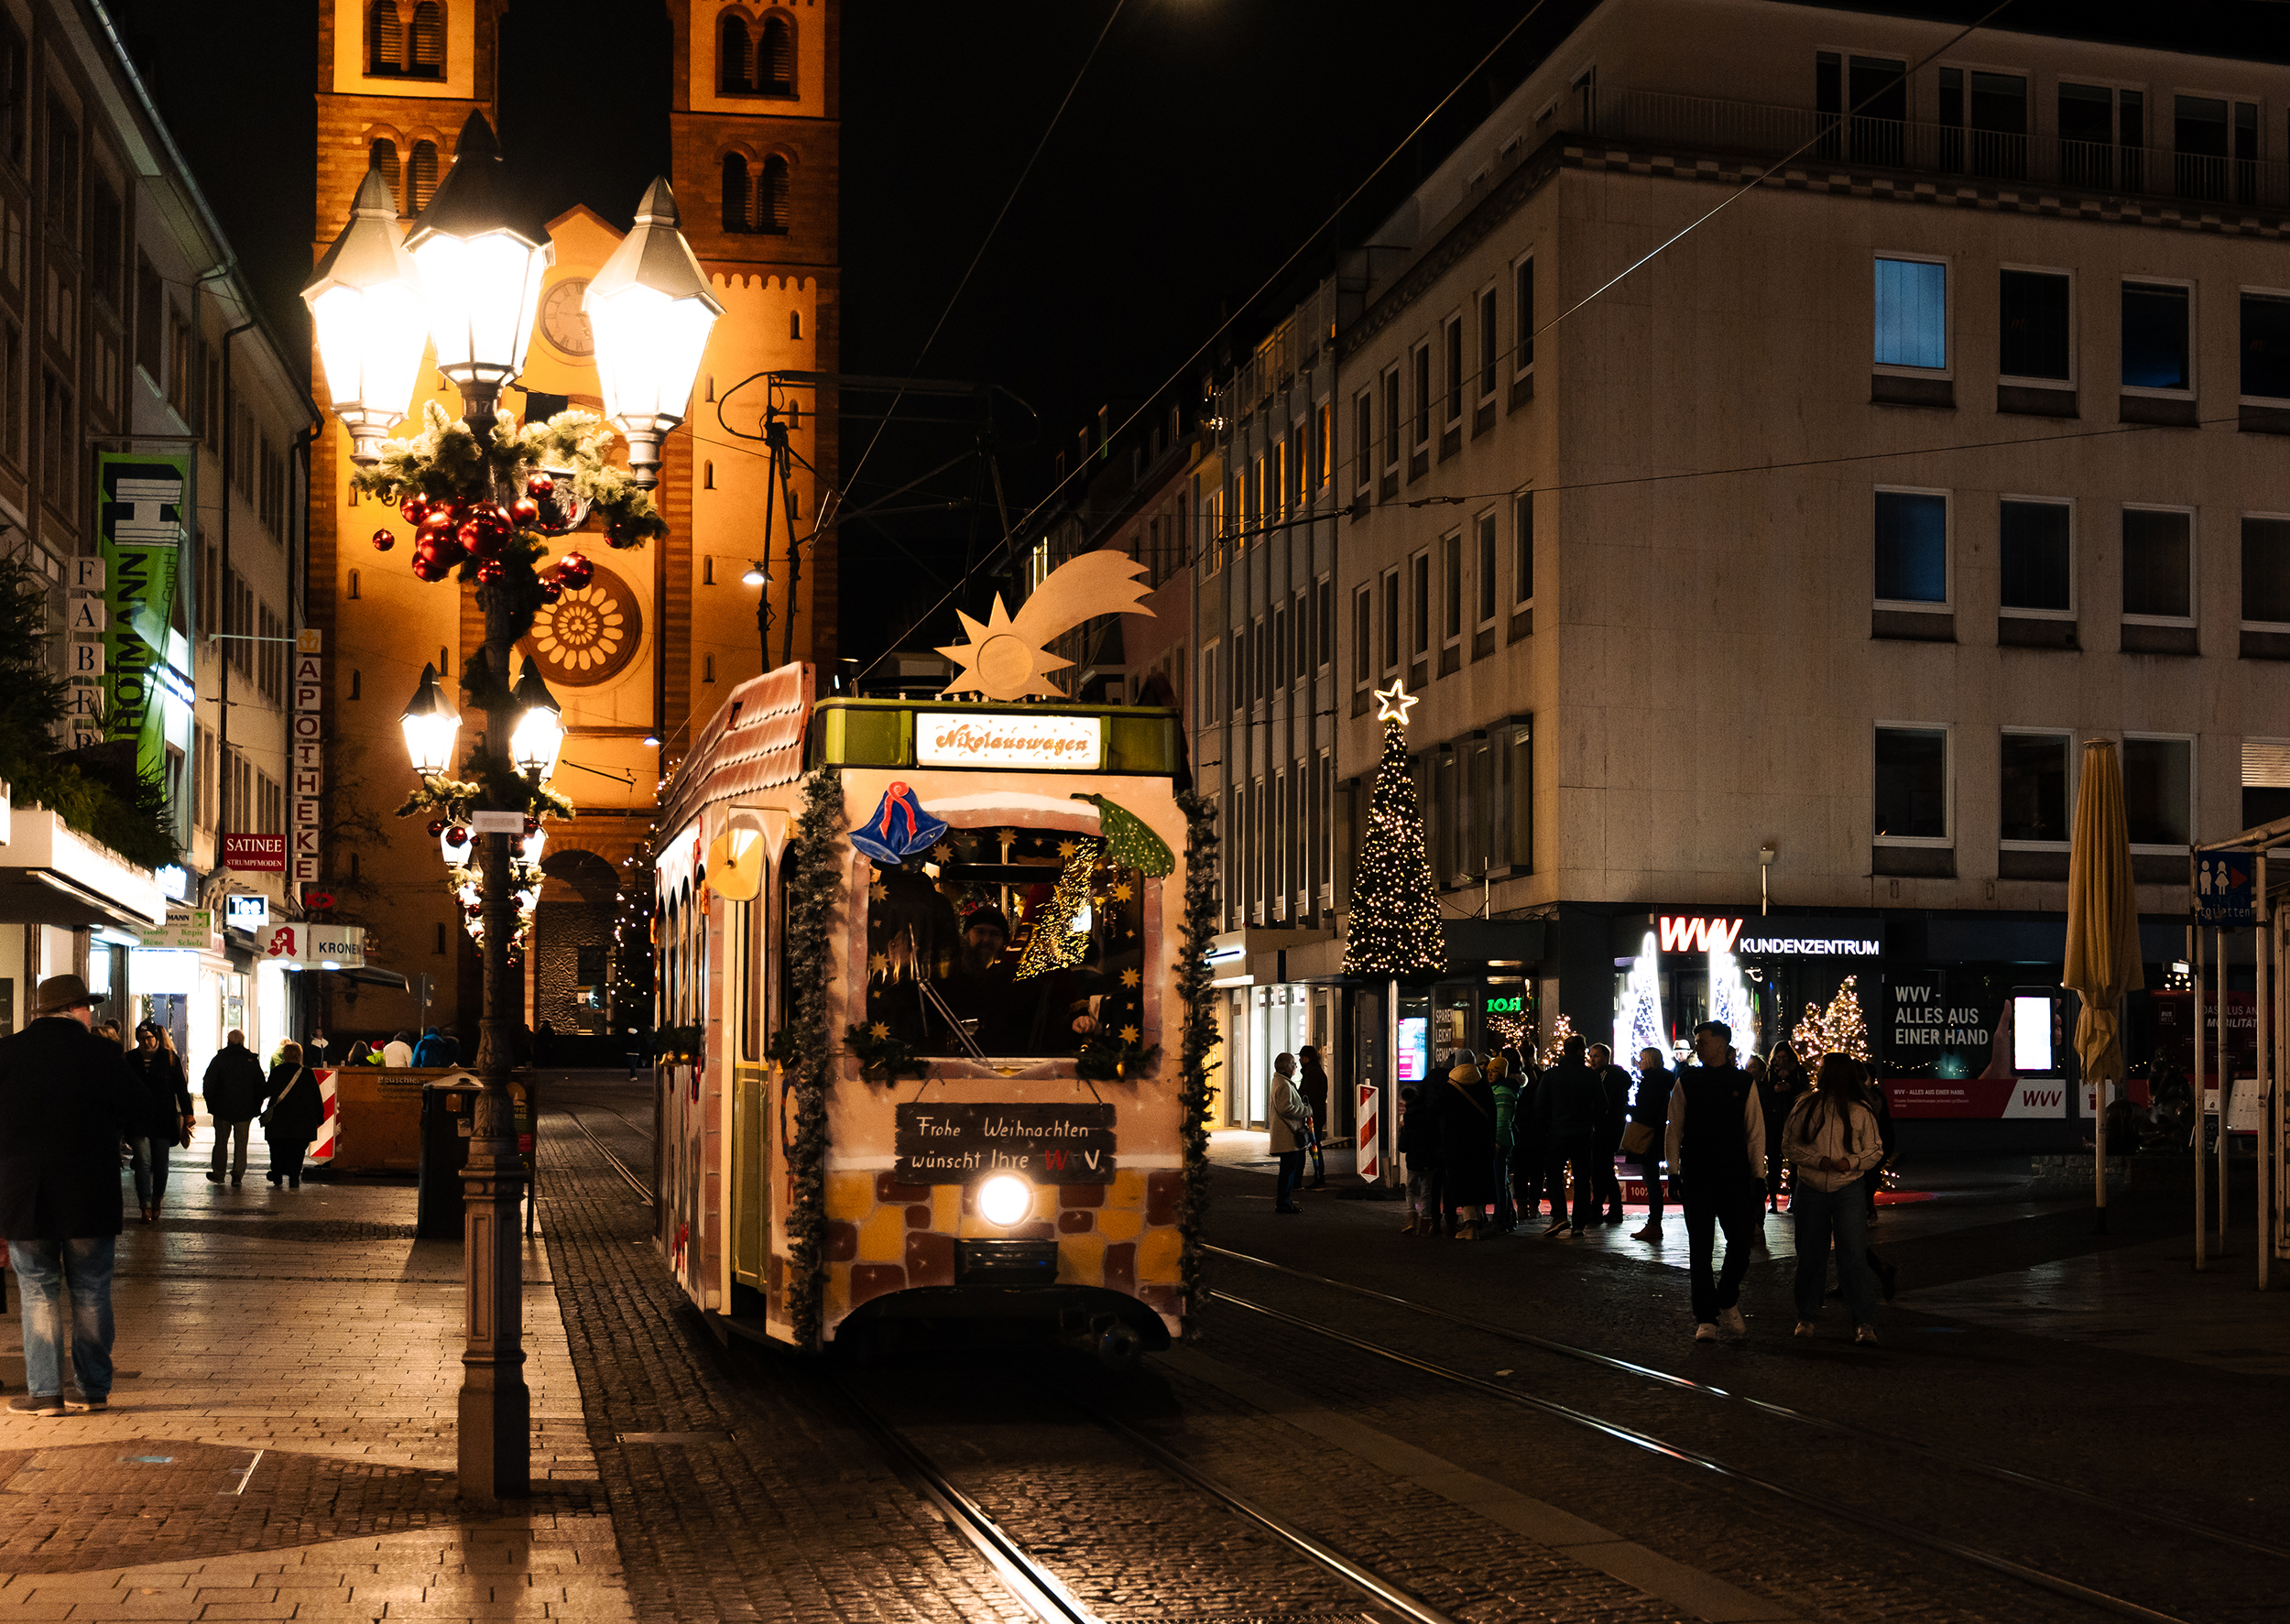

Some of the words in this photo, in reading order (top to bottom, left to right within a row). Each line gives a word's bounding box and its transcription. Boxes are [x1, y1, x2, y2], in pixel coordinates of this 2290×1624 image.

[935, 724, 1088, 756] Nikolauswagen
[296, 659, 319, 878] APOTHEKE
[226, 838, 283, 853] SATINEE
[226, 858, 282, 867] STRUMPFMODEN
[231, 897, 262, 915] Tee
[1660, 917, 1744, 953] WVV
[1739, 938, 1880, 955] KUNDENZENTRUM
[1894, 986, 1931, 1003] WVV
[1894, 1007, 1944, 1024] ALLES
[1947, 1008, 1979, 1024] AUS
[2226, 1006, 2243, 1016] LUS
[1895, 1028, 1940, 1045] EINER
[1945, 1029, 1989, 1045] HAND
[2023, 1090, 2063, 1106] WVV
[916, 1117, 961, 1137] Frohe
[984, 1117, 1089, 1138] Weihnachten
[911, 1150, 982, 1169] wünscht
[991, 1149, 1030, 1169] Ihre
